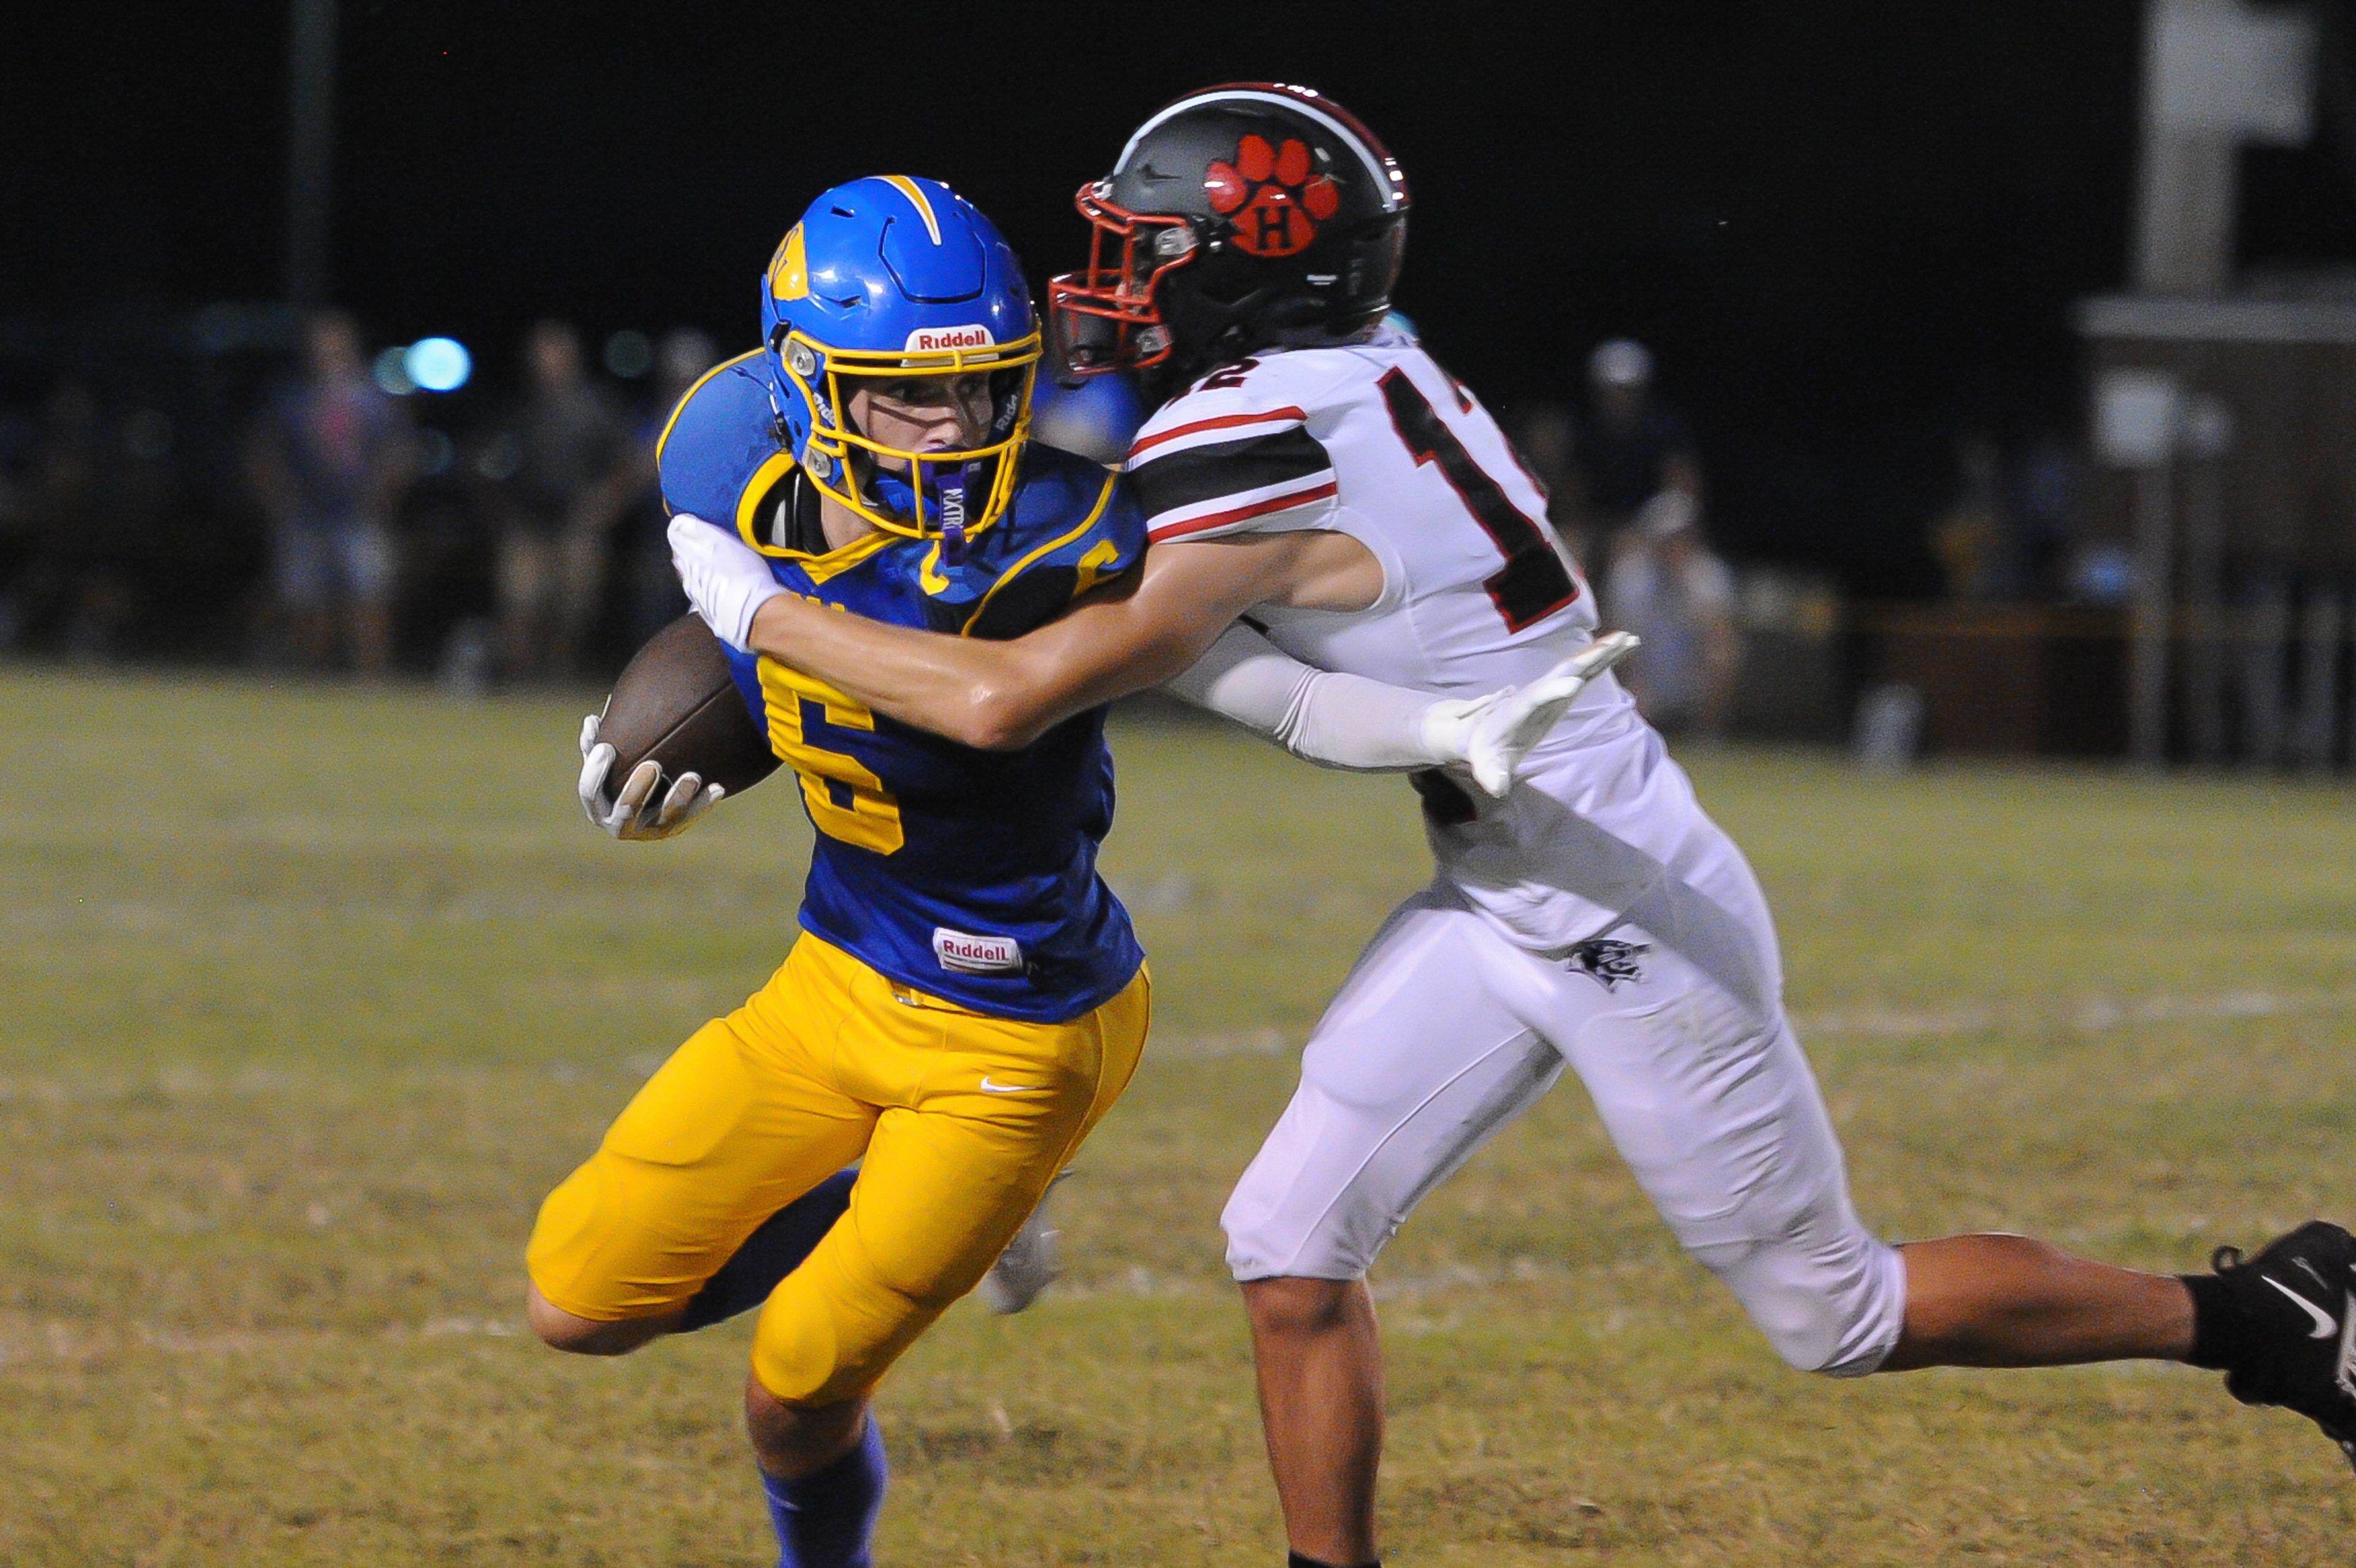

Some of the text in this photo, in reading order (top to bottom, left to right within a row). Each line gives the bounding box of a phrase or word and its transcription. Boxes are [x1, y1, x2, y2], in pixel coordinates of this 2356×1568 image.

[1254, 206, 1292, 250] H
[919, 329, 987, 350] Riddell
[756, 655, 904, 856] 6
[943, 940, 1007, 961] Riddell
